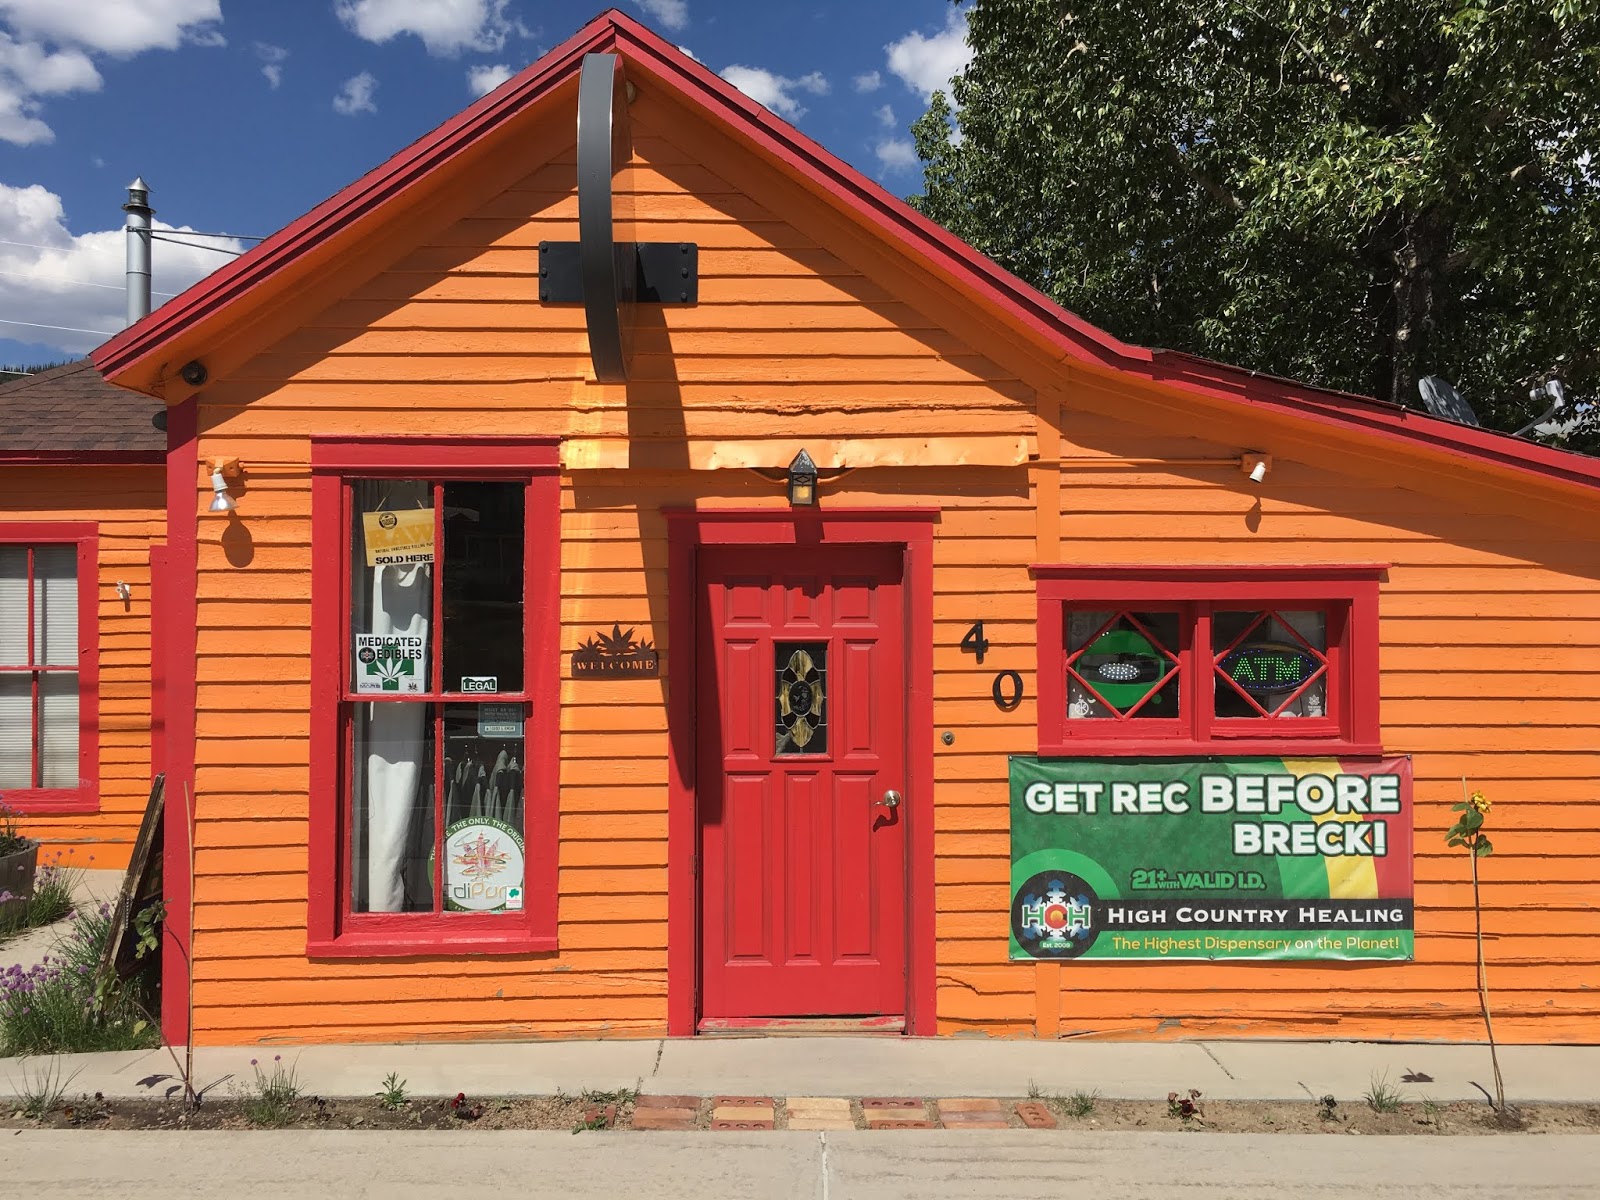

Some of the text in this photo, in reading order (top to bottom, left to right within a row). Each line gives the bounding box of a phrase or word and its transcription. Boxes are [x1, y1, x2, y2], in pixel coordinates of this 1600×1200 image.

[367, 524, 435, 549] RAW
[375, 554, 434, 565] SOLD HERE
[358, 637, 422, 647] MEDICATED
[377, 649, 422, 659] EDIBLES
[576, 660, 654, 670] WELCOME
[1231, 657, 1301, 681] ATM
[463, 682, 495, 691] LEGAL
[1024, 775, 1401, 814] GET REC BEFORE
[451, 820, 467, 831] THE
[492, 819, 507, 830] THE
[507, 828, 525, 853] ORIGIN
[1233, 821, 1387, 855] BRECK!
[1132, 869, 1266, 889] 21+ WITH VALID I.D.
[1022, 903, 1092, 930] HCH
[1112, 936, 1399, 954] The Highest Dispensary on the Planet!
